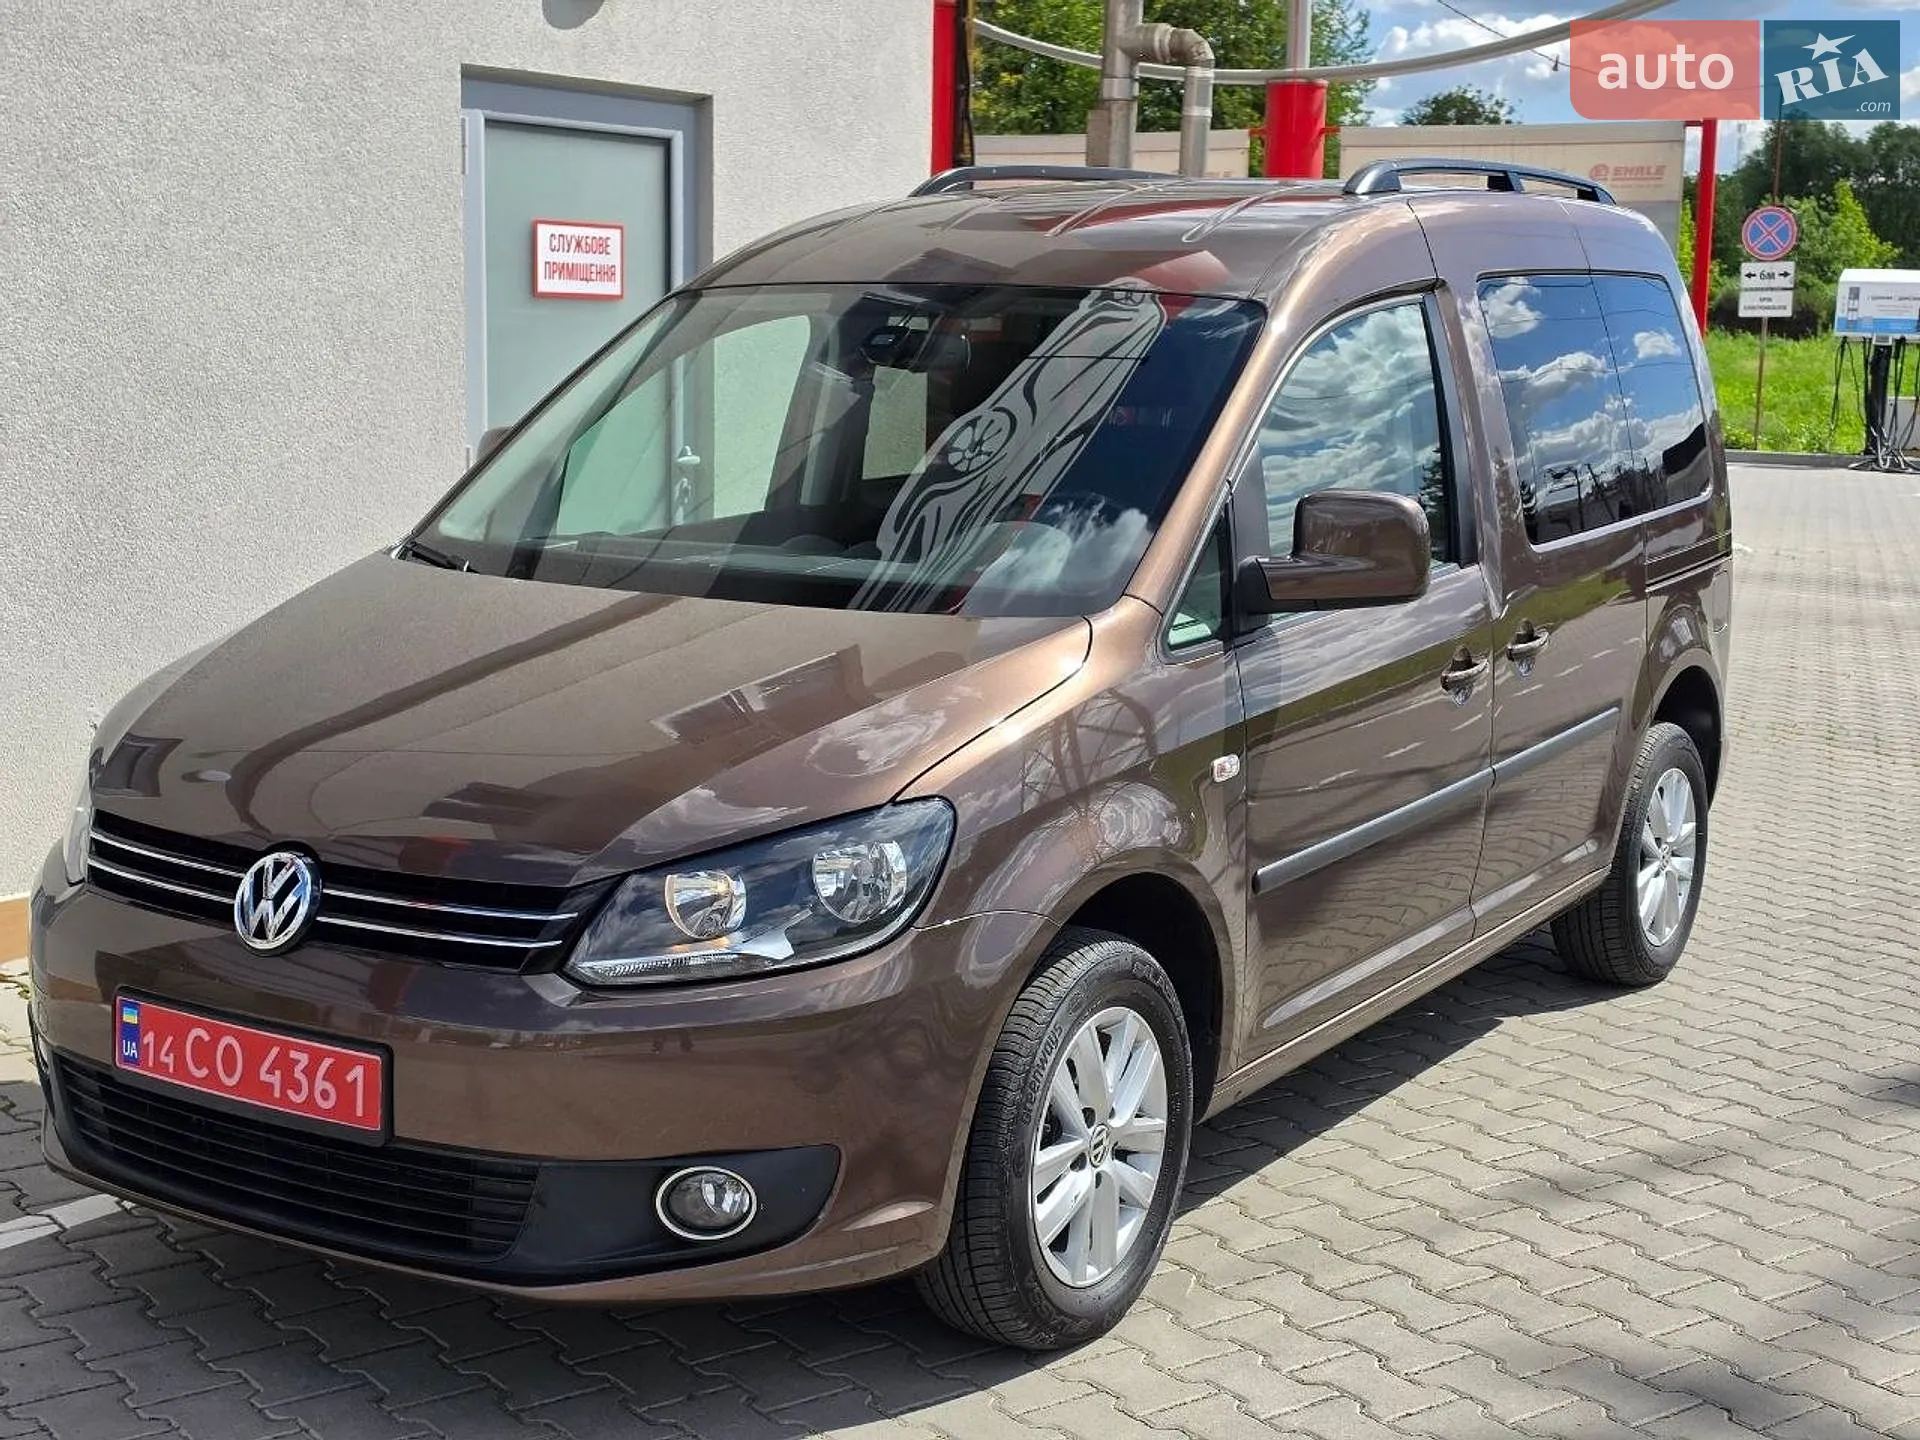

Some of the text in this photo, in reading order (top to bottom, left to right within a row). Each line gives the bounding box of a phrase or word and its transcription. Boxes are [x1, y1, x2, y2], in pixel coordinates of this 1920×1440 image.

[549, 233, 611, 255] СЛУЖБОВЕ
[544, 261, 616, 284] ПРИМІЩЕННЯ
[122, 1040, 138, 1058] UA
[259, 1046, 364, 1117] 4361
